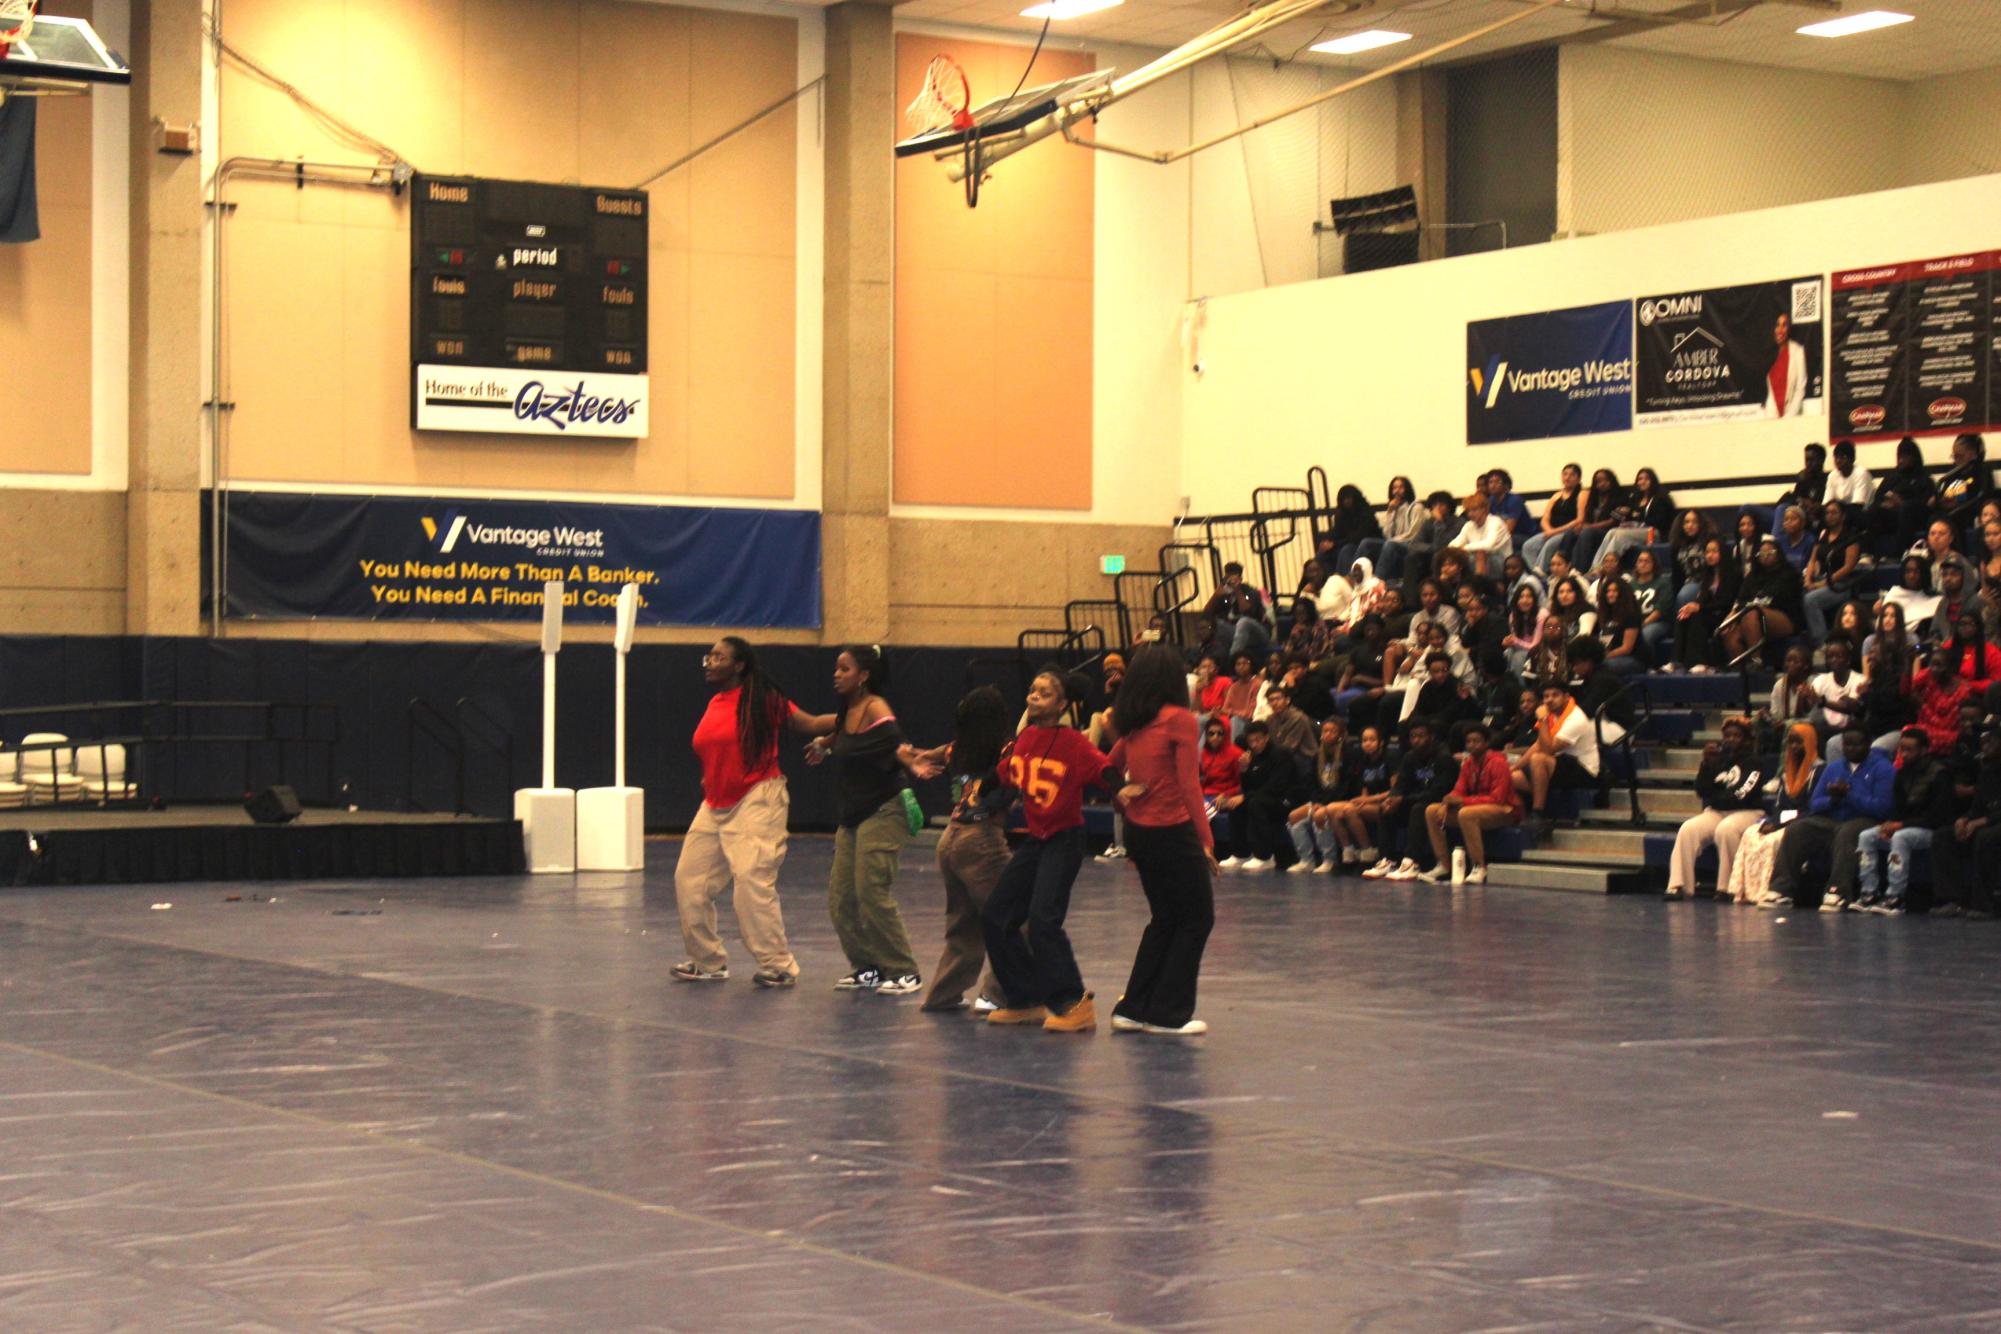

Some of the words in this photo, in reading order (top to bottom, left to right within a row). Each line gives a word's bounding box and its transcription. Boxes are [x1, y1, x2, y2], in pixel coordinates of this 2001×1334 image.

[430, 182, 468, 202] Home
[597, 194, 642, 215] Guests
[513, 247, 557, 267] period
[513, 278, 557, 299] player
[1655, 294, 1702, 318] OMNI
[517, 345, 552, 363] game
[1508, 367, 1582, 393] Vantage
[1584, 358, 1631, 384] West
[1665, 364, 1730, 383] CORDOVA
[426, 379, 466, 396] Home
[470, 380, 484, 396] of
[487, 381, 508, 397] the
[1568, 387, 1601, 400] CREDIT
[1602, 384, 1631, 396] UNION
[466, 524, 550, 548] Vantage
[553, 526, 604, 547] West
[536, 547, 572, 556] CREDIT
[574, 549, 604, 558] UNION
[360, 560, 399, 578] You
[405, 560, 456, 579] Need
[461, 562, 511, 580] More
[515, 563, 564, 581] Than
[568, 564, 583, 582] A
[587, 565, 660, 584] Banker.
[371, 585, 411, 603] You
[415, 586, 467, 604] Need
[471, 587, 486, 604] A
[491, 588, 579, 606] Finanal
